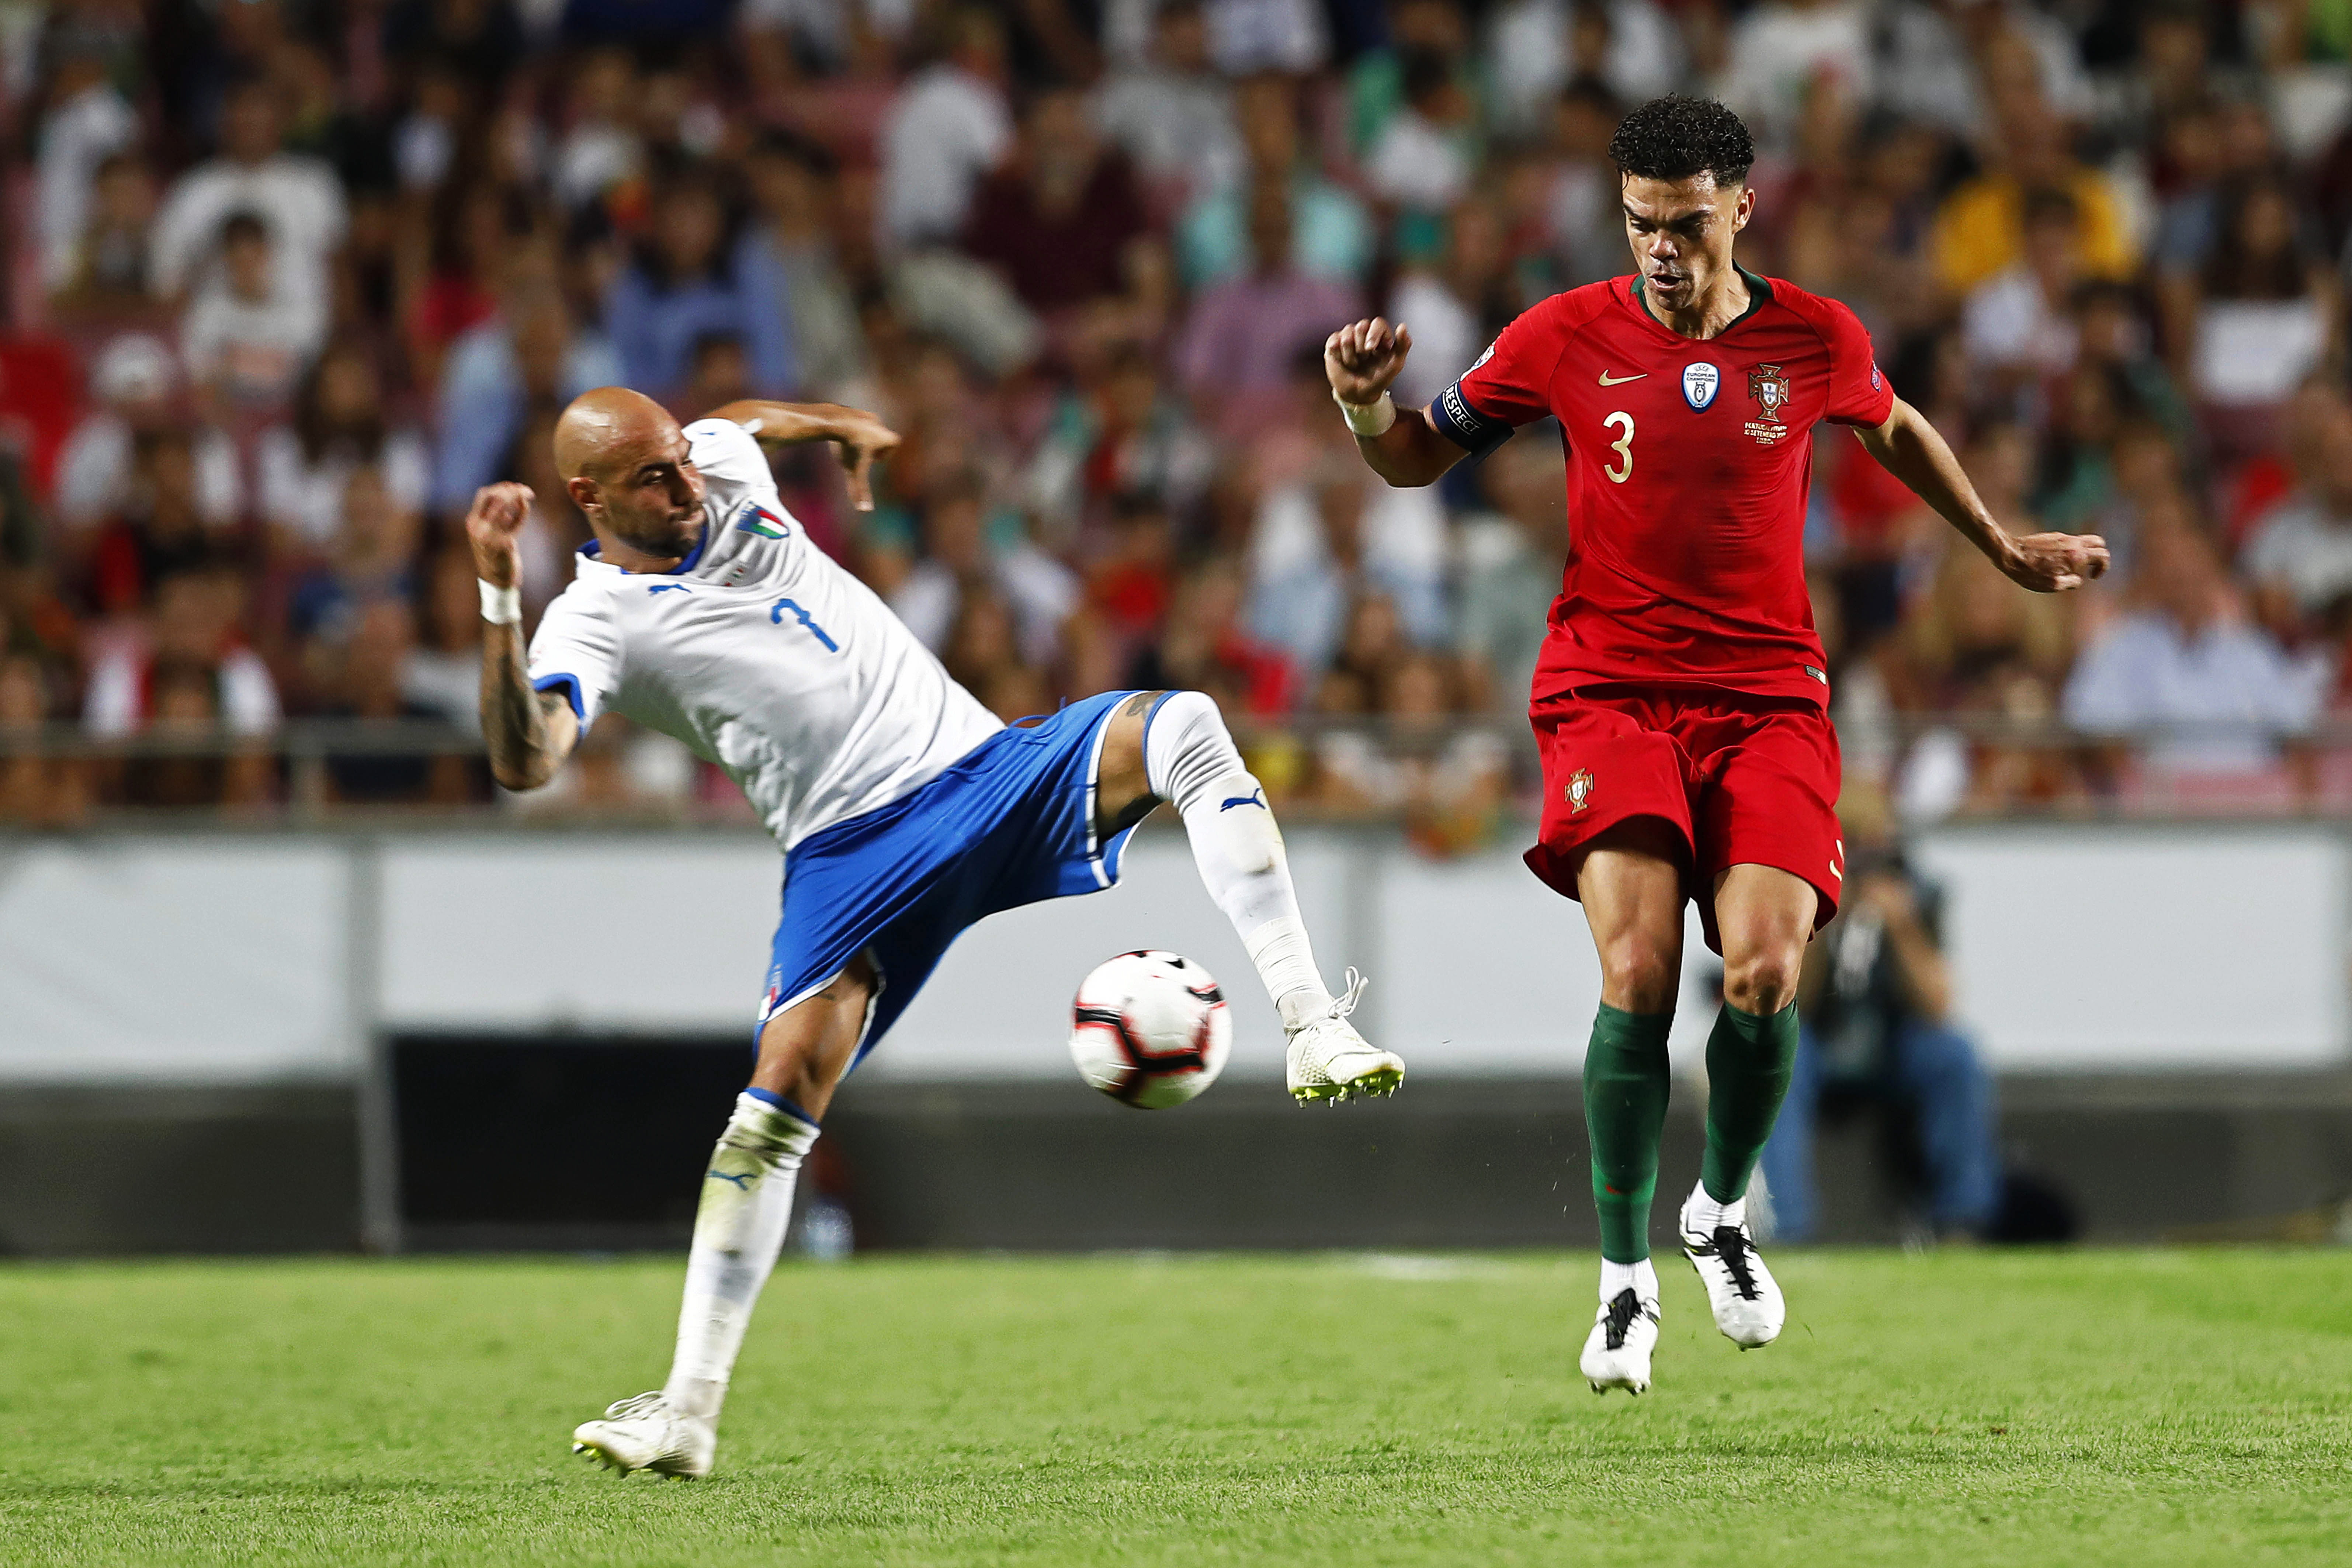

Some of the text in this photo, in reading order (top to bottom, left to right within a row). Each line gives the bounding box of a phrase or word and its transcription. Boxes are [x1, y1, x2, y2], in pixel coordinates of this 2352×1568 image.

[1445, 386, 1480, 431] RESPECT
[1603, 411, 1634, 483] 3
[770, 598, 838, 652] 7
